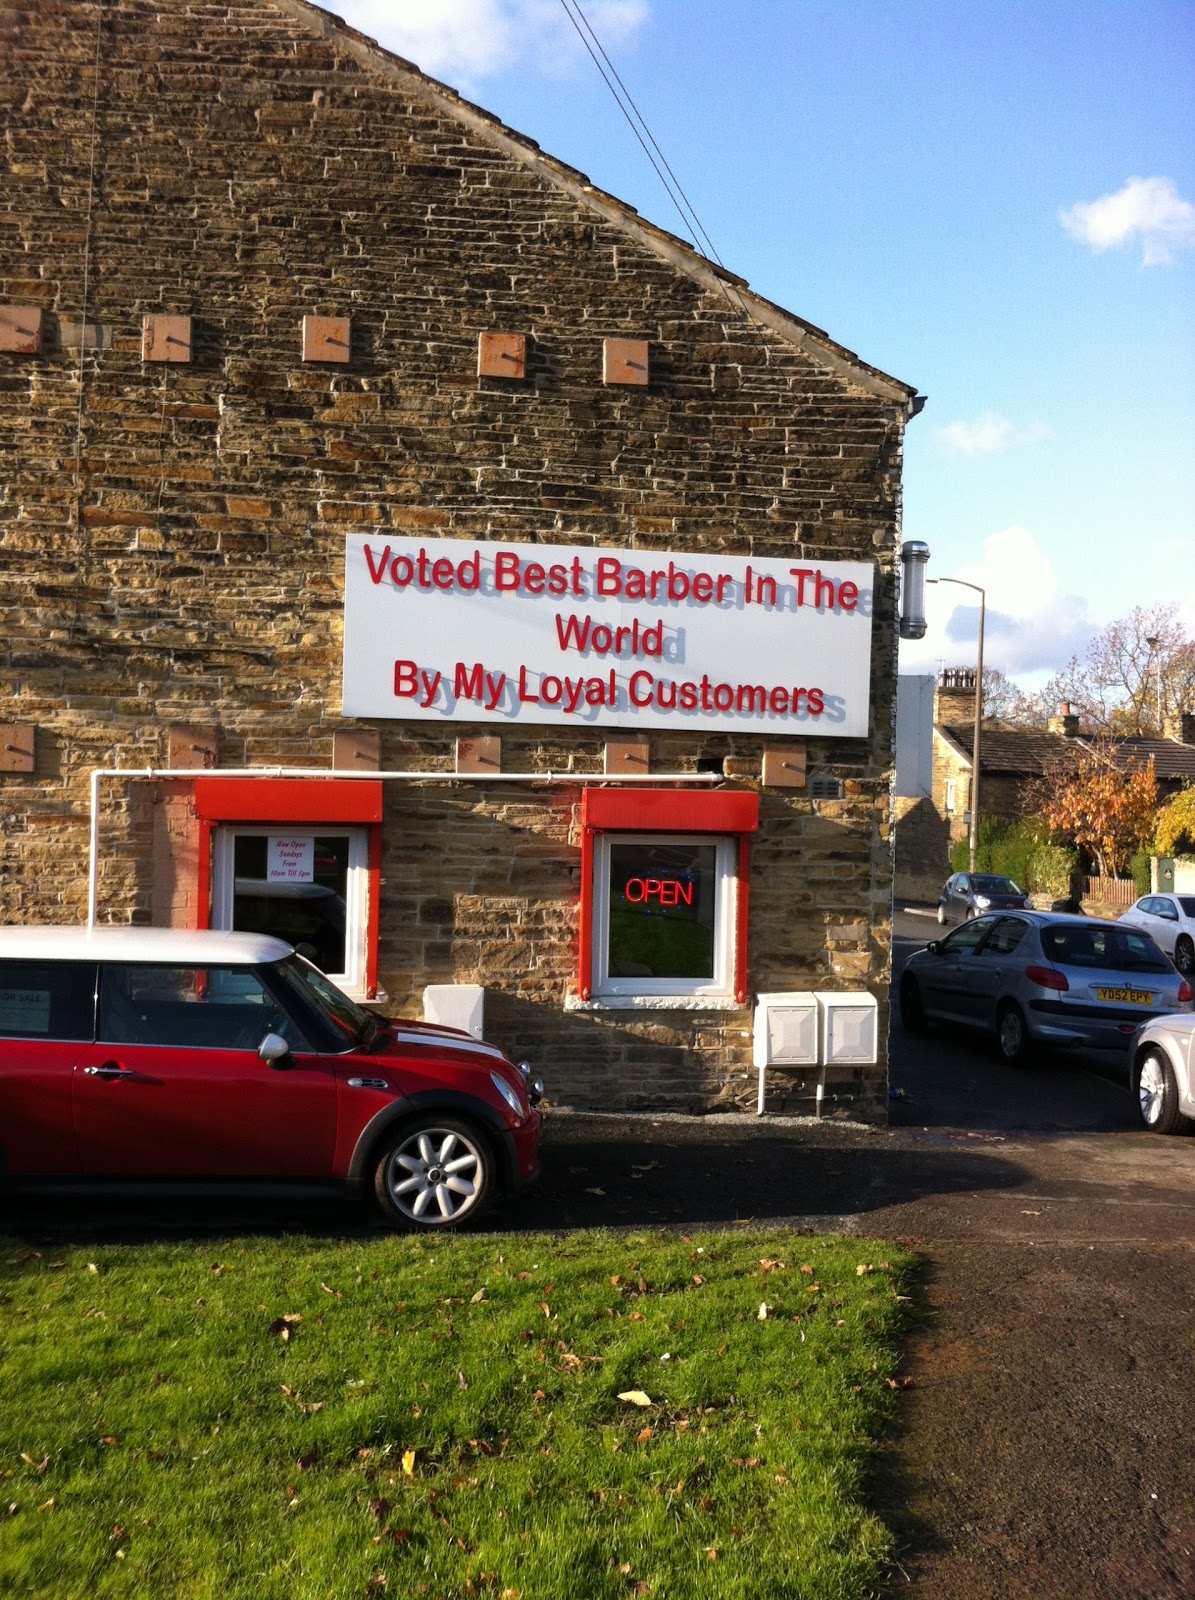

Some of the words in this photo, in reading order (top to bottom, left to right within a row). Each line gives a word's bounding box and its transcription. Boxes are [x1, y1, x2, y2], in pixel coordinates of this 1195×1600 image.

[364, 544, 480, 590] Voted
[495, 551, 585, 595] Best
[597, 557, 732, 604] Barber
[745, 565, 776, 605] In
[790, 568, 858, 611] The
[556, 613, 662, 656] World
[394, 660, 441, 709] By
[455, 662, 505, 711] My
[519, 665, 615, 714] Loyal
[629, 670, 825, 716] Customers
[279, 850, 302, 859] Sundays
[291, 841, 305, 849] Open
[625, 877, 693, 906] OPEN
[1, 993, 16, 1001] OR
[19, 993, 41, 1002] SALE
[1102, 989, 1128, 1001] YD52
[1130, 991, 1149, 1003] EPY
